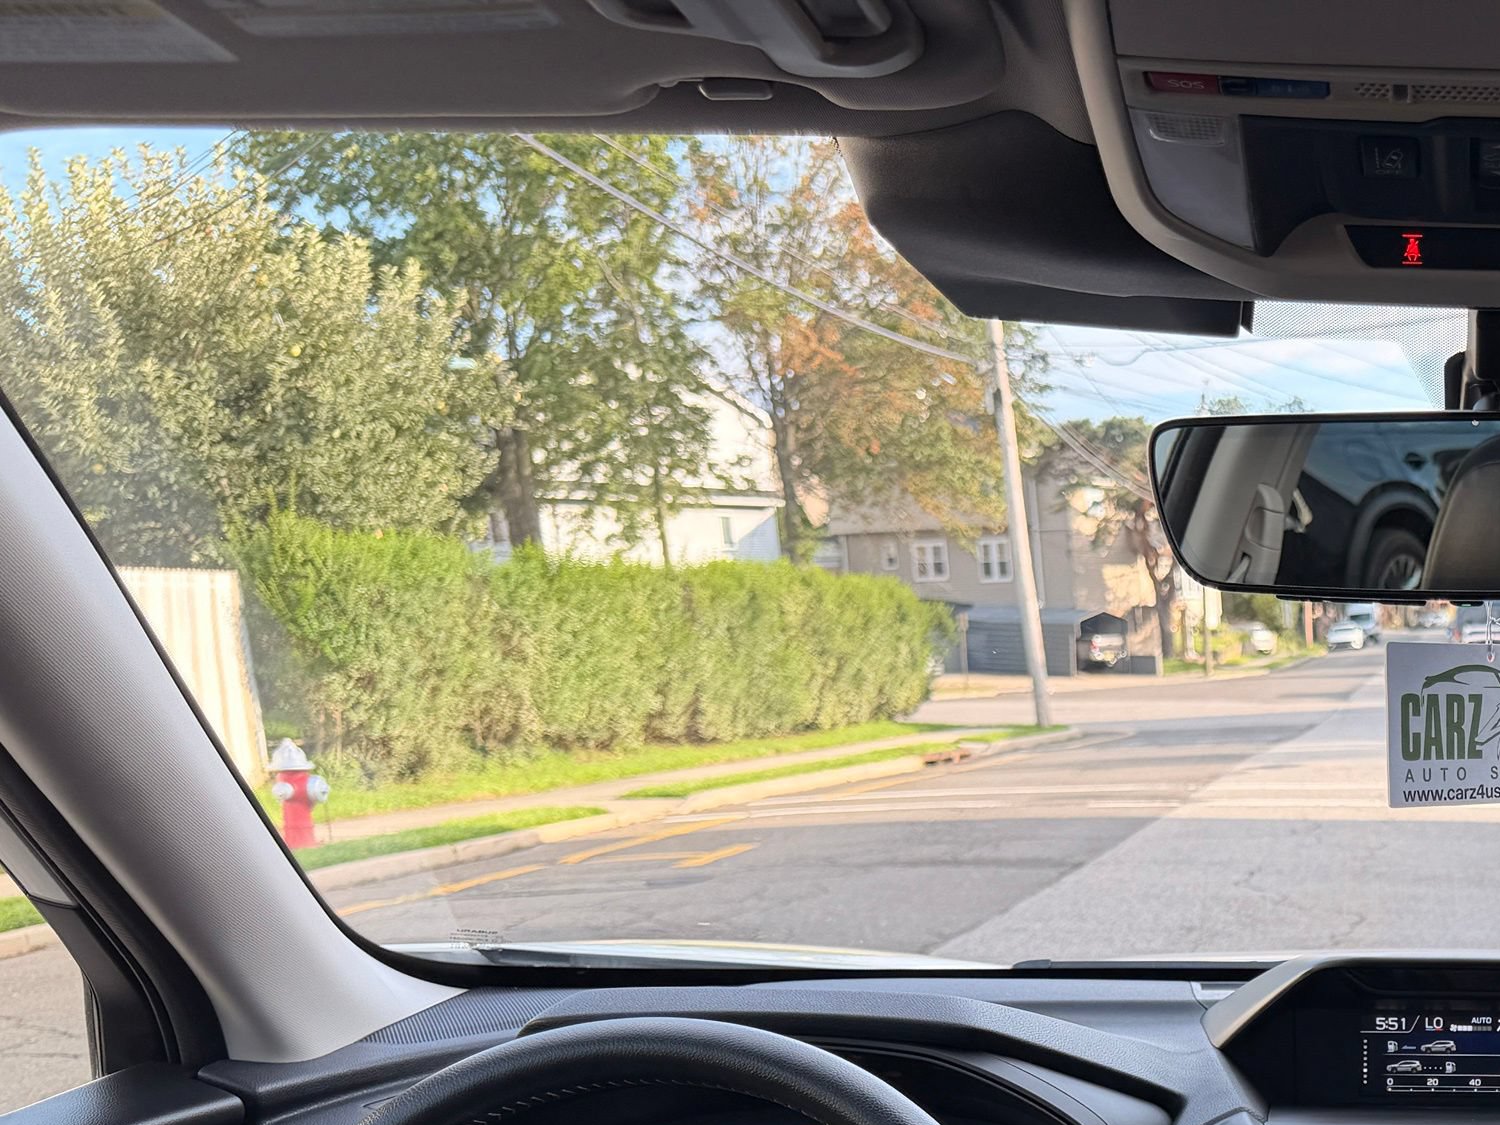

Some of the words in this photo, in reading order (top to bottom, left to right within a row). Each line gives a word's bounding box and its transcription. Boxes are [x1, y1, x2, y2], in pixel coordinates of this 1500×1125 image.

[1167, 79, 1204, 89] SOS
[1401, 693, 1484, 761] CARZ
[1405, 767, 1467, 782] AUTO
[1376, 1017, 1407, 1030] 5:51
[1425, 1016, 1444, 1030] LO
[1386, 1078, 1394, 1086] 0
[1426, 1078, 1438, 1086] 20
[1468, 1078, 1482, 1087] 40
